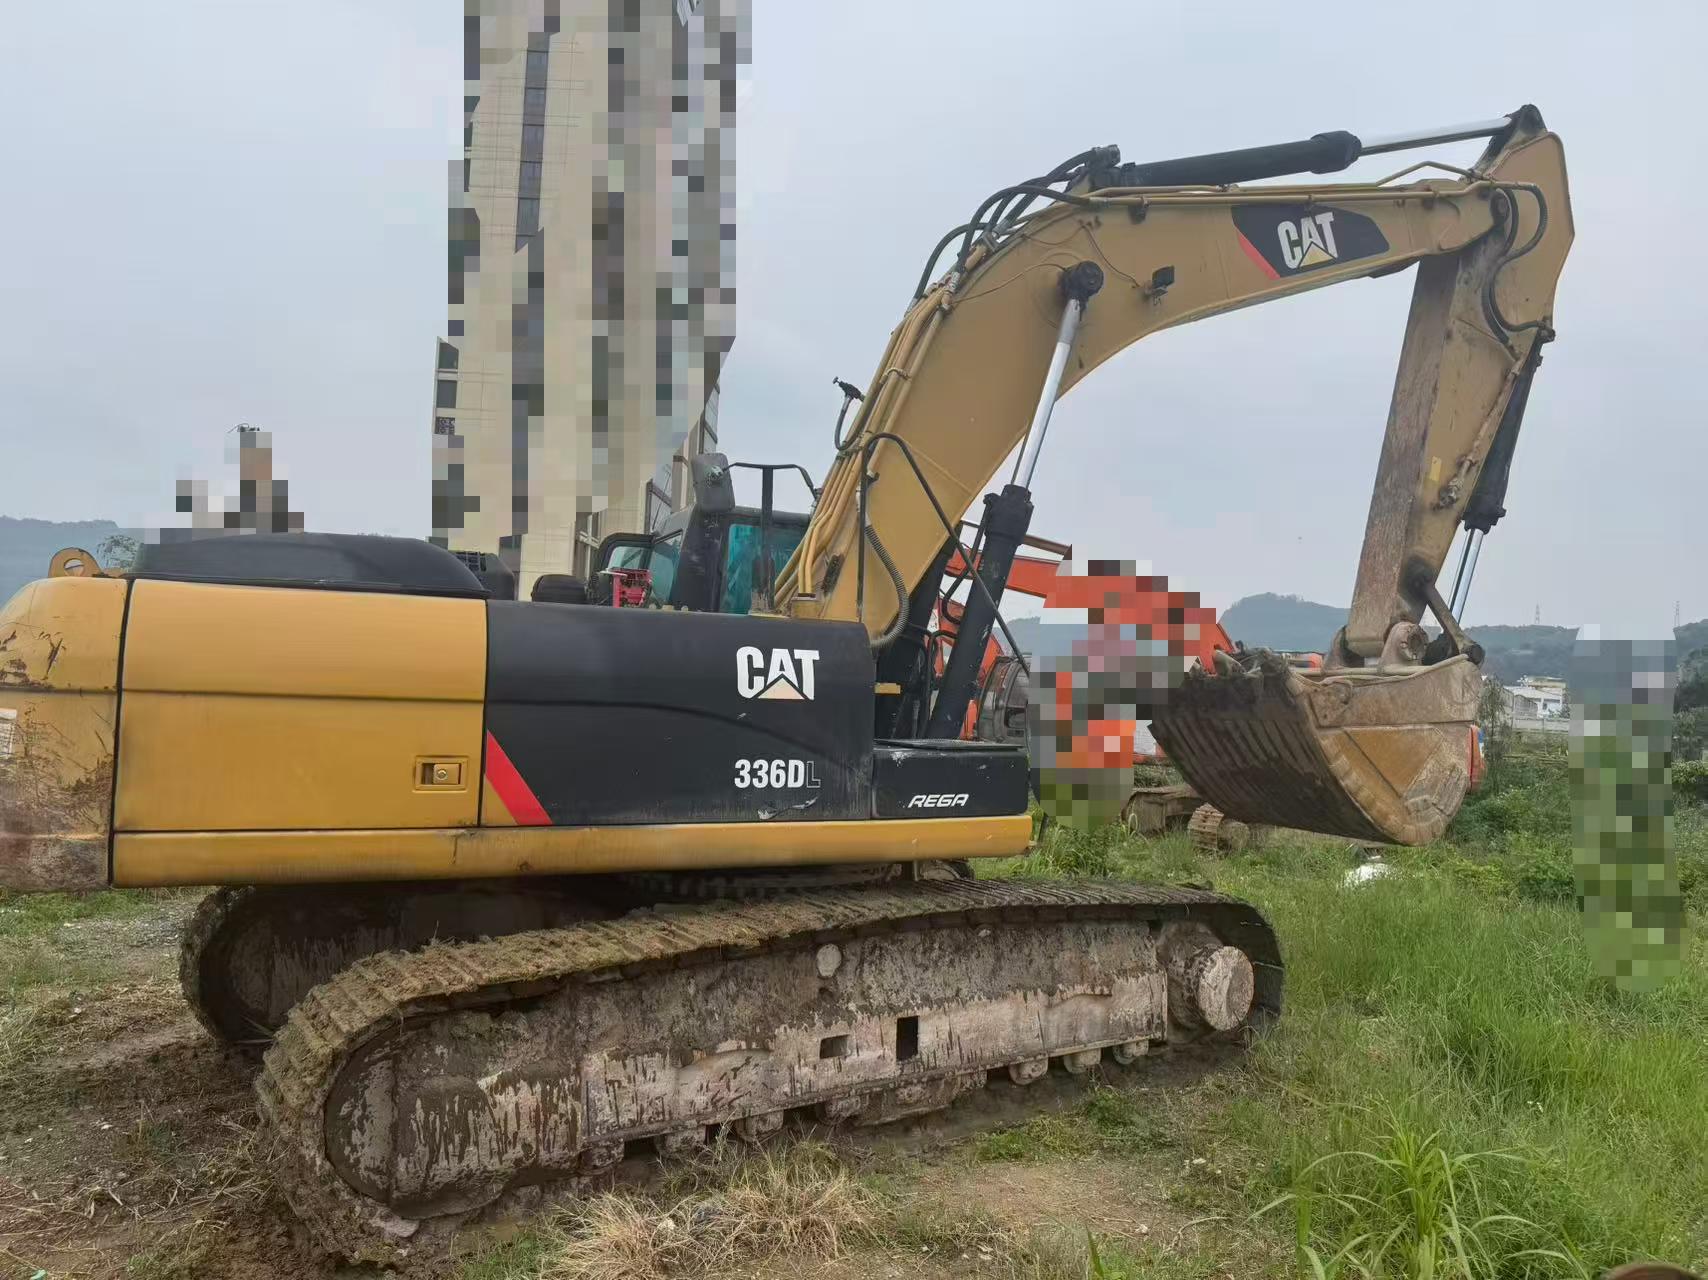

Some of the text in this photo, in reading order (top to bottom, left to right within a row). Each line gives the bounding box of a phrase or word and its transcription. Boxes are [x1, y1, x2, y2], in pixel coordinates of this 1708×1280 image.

[1277, 211, 1338, 269] CAT
[736, 646, 820, 700] CAT
[908, 794, 969, 808] REGA
